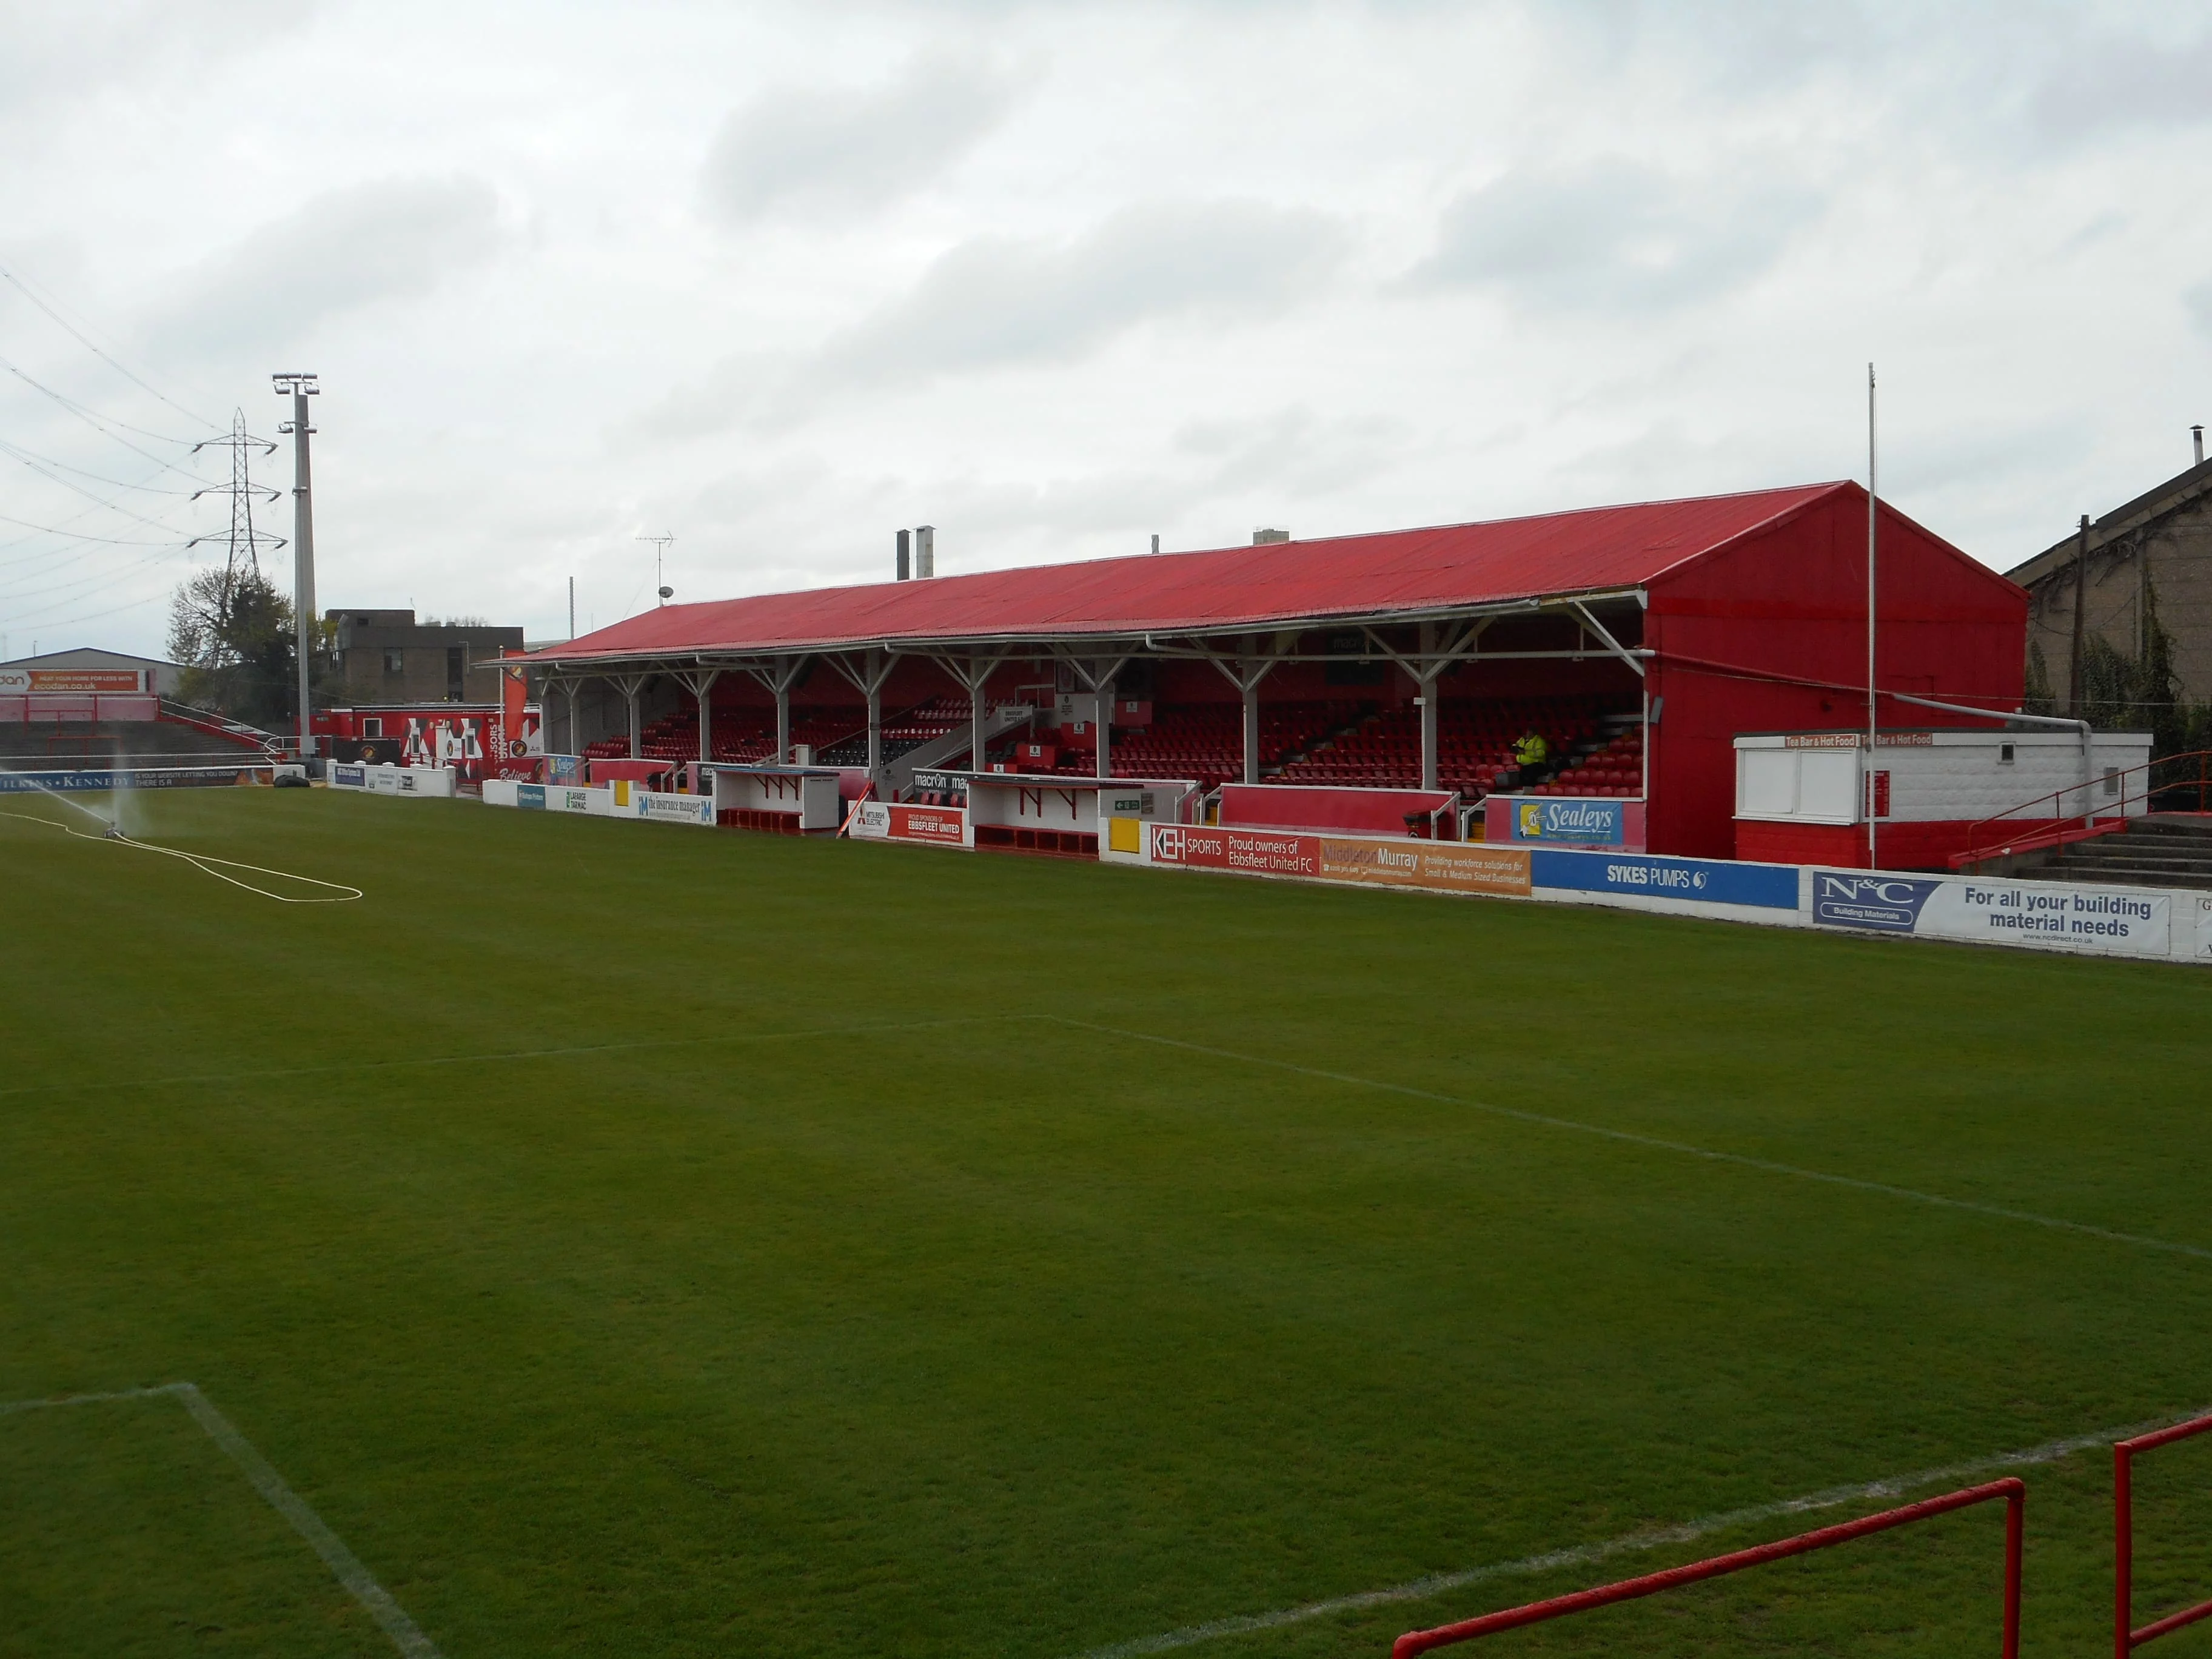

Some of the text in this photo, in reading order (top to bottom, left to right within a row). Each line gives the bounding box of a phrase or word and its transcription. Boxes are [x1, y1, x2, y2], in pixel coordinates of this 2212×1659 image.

[1786, 736, 1855, 746] Tea Bar & Hot Food
[1876, 736, 1889, 745] Bar
[1891, 736, 1896, 745] &
[1897, 735, 1911, 745] Hot
[1912, 735, 1931, 745] Food
[63, 776, 129, 787] KENNEDY
[499, 768, 531, 781] Believe
[914, 773, 946, 788] macron
[571, 791, 586, 801] LAFARGE
[571, 800, 586, 810] TARMAC
[656, 795, 679, 811] insurance
[679, 800, 700, 816] manager
[866, 811, 885, 820] MITSUBISHI
[1546, 803, 1613, 833] Sealeys
[908, 820, 959, 834] EBBSFLEET UNITED
[1153, 828, 1221, 860] KEH SPORTS
[1229, 836, 1298, 854] Proud owners of
[1229, 851, 1268, 869] Ebbsfleet
[1270, 856, 1299, 871] United
[1301, 858, 1313, 873] FC
[1425, 856, 1523, 872] Providing workforce solutions for
[1425, 868, 1441, 877] Small
[1449, 870, 1472, 880] Medium
[1474, 872, 1491, 882] Sized
[1492, 874, 1526, 885] Businesses
[1607, 865, 1690, 888] SYKES PUMPS
[1821, 877, 1914, 904] N&C
[1965, 887, 2151, 920] For all your building
[1834, 907, 1900, 920] Building Materials
[1989, 912, 2130, 937] material needs
[2022, 934, 2093, 944] www.ncdirect.co.uk
